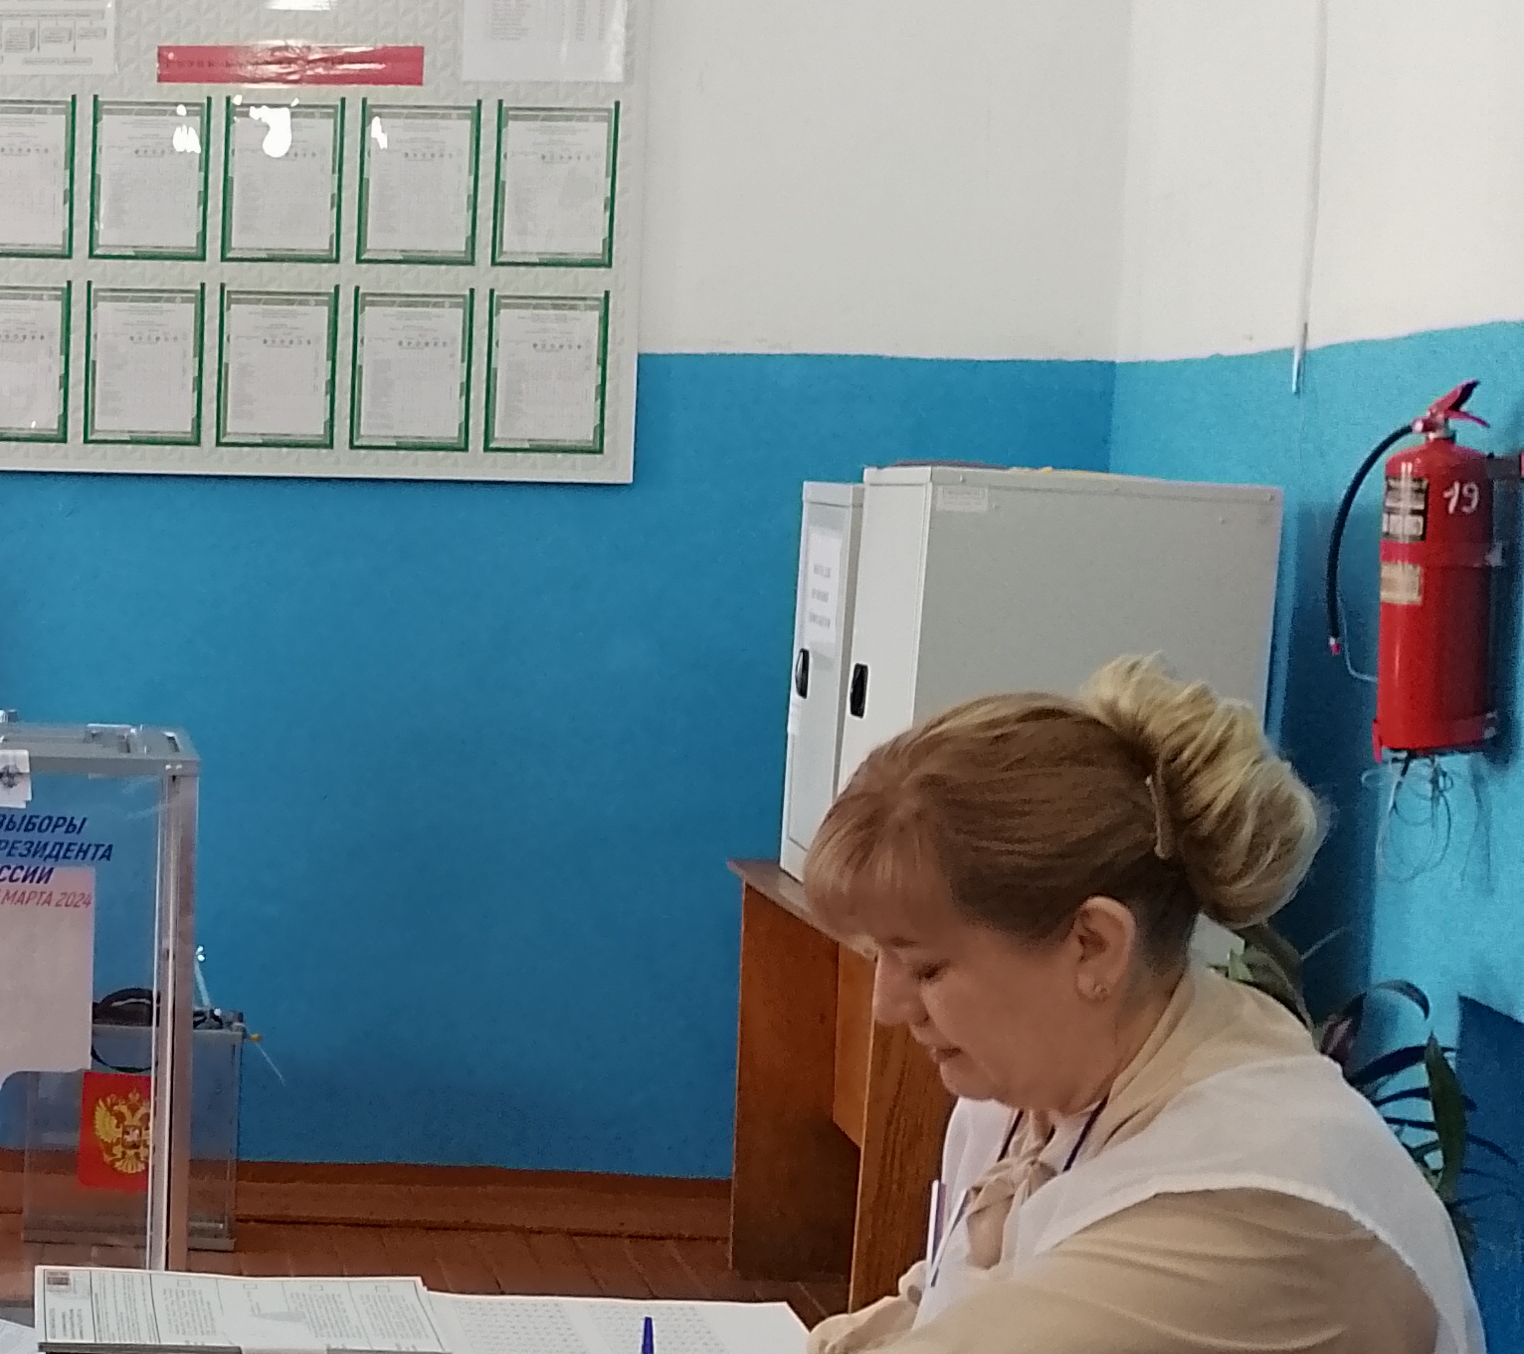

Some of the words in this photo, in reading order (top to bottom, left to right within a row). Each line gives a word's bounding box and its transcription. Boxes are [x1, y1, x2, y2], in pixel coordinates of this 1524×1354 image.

[1443, 480, 1481, 515] 19
[2, 889, 52, 907] МАРТА
[55, 891, 92, 909] 2024
